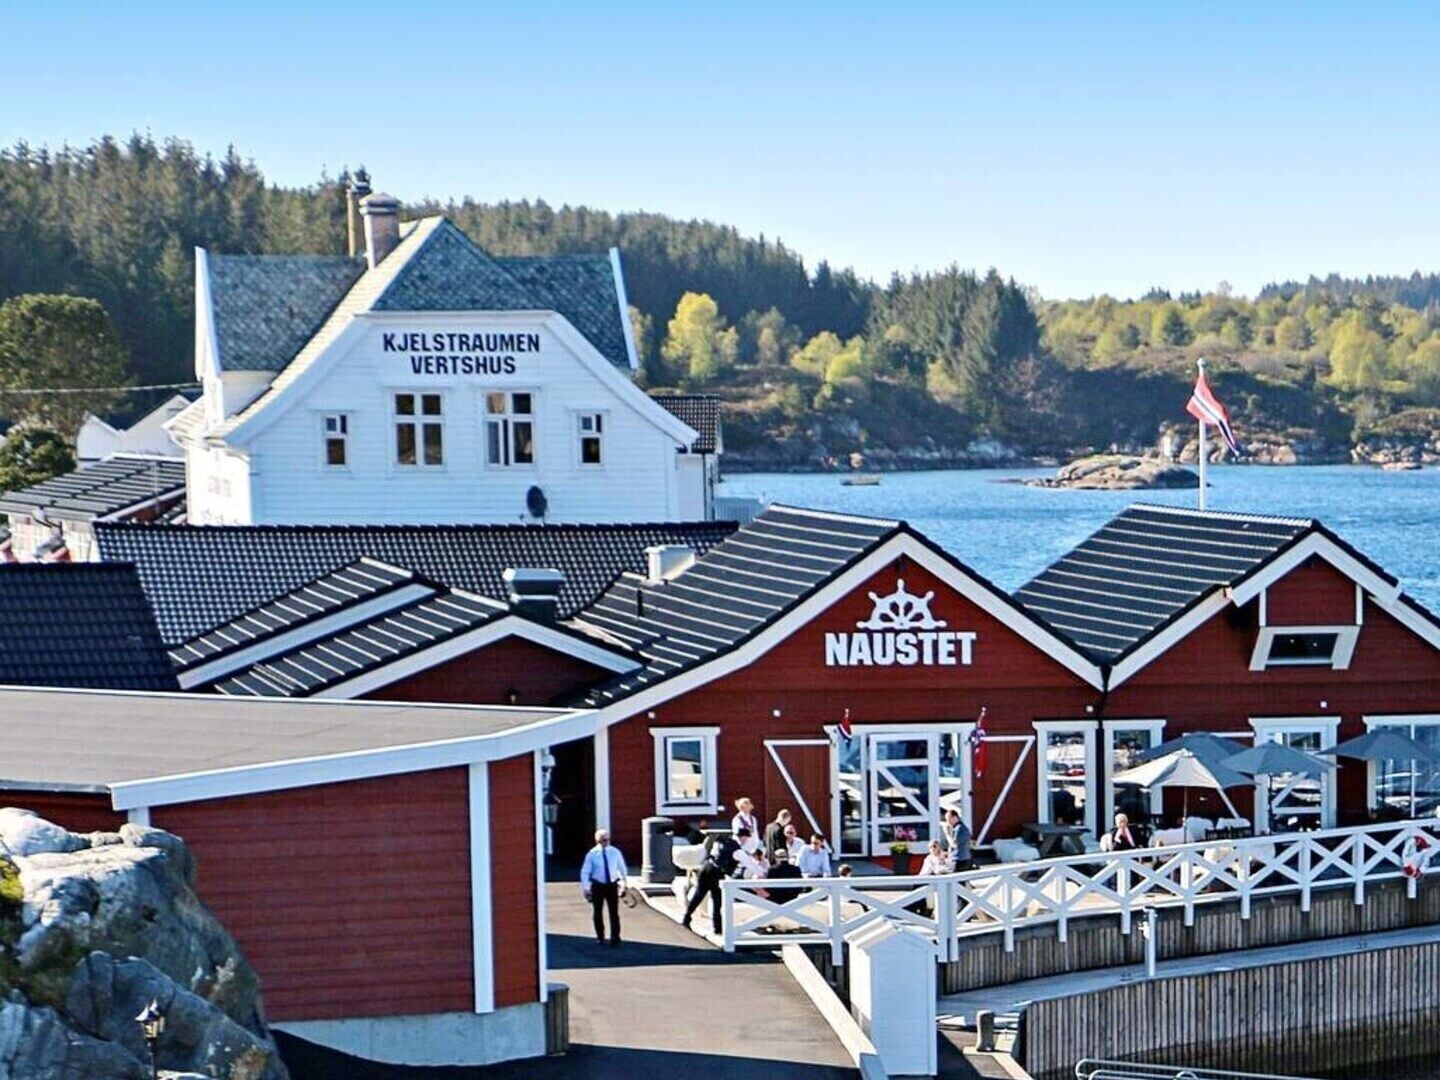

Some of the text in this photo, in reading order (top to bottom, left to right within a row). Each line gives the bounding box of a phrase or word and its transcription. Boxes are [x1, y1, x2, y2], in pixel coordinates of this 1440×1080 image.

[382, 333, 540, 353] KJELSTRAUMEN
[410, 355, 517, 375] VERTSHUS
[824, 632, 977, 666] NAUSTET
